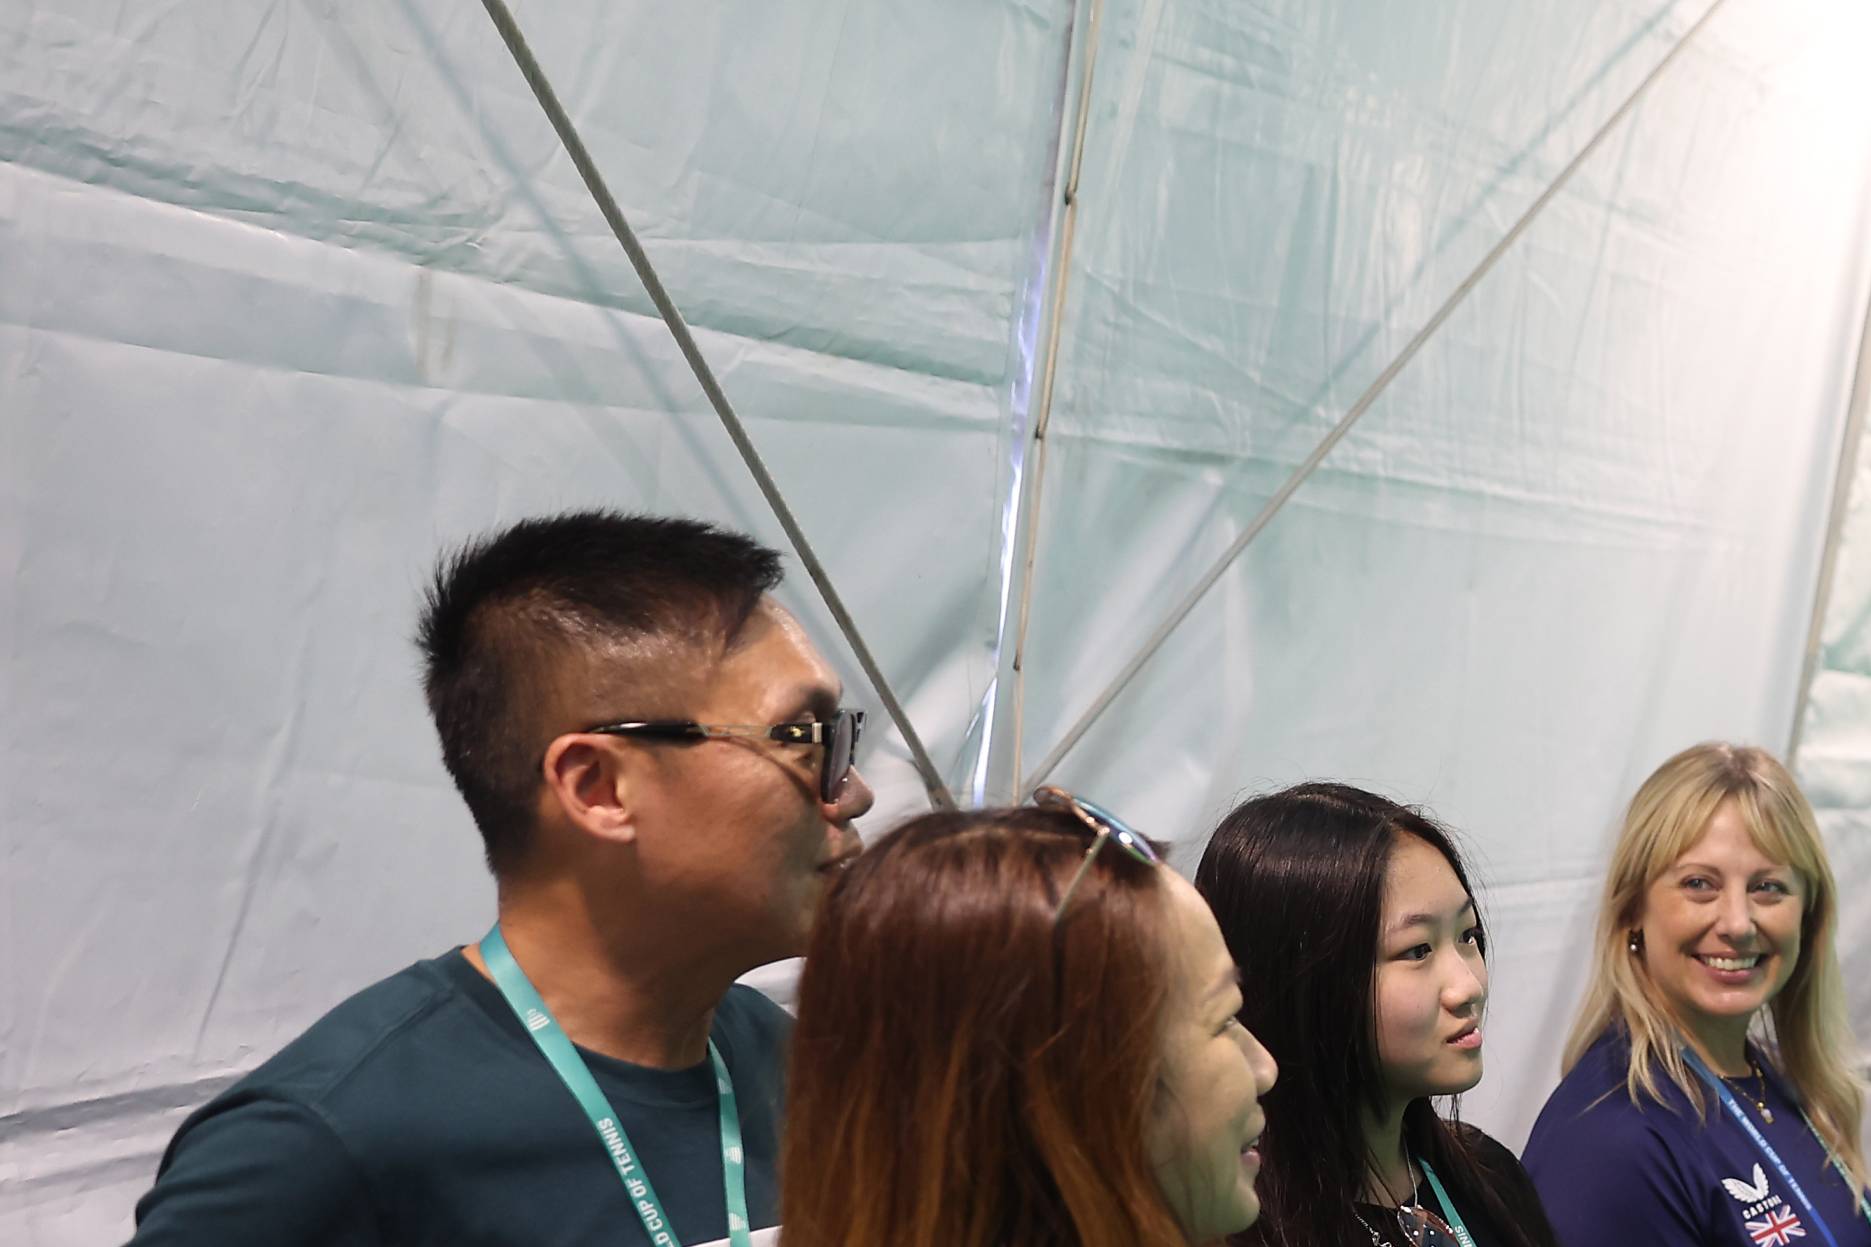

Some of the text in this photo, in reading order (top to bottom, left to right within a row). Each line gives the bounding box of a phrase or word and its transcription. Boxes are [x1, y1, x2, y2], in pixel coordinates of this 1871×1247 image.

[598, 1117, 636, 1176] TENNIS
[1728, 1099, 1743, 1120] THE
[1742, 1117, 1767, 1148] WORLD
[1765, 1146, 1781, 1165] CUP
[1778, 1163, 1790, 1176] OF
[625, 1177, 647, 1197] OF
[638, 1199, 663, 1232] CUP
